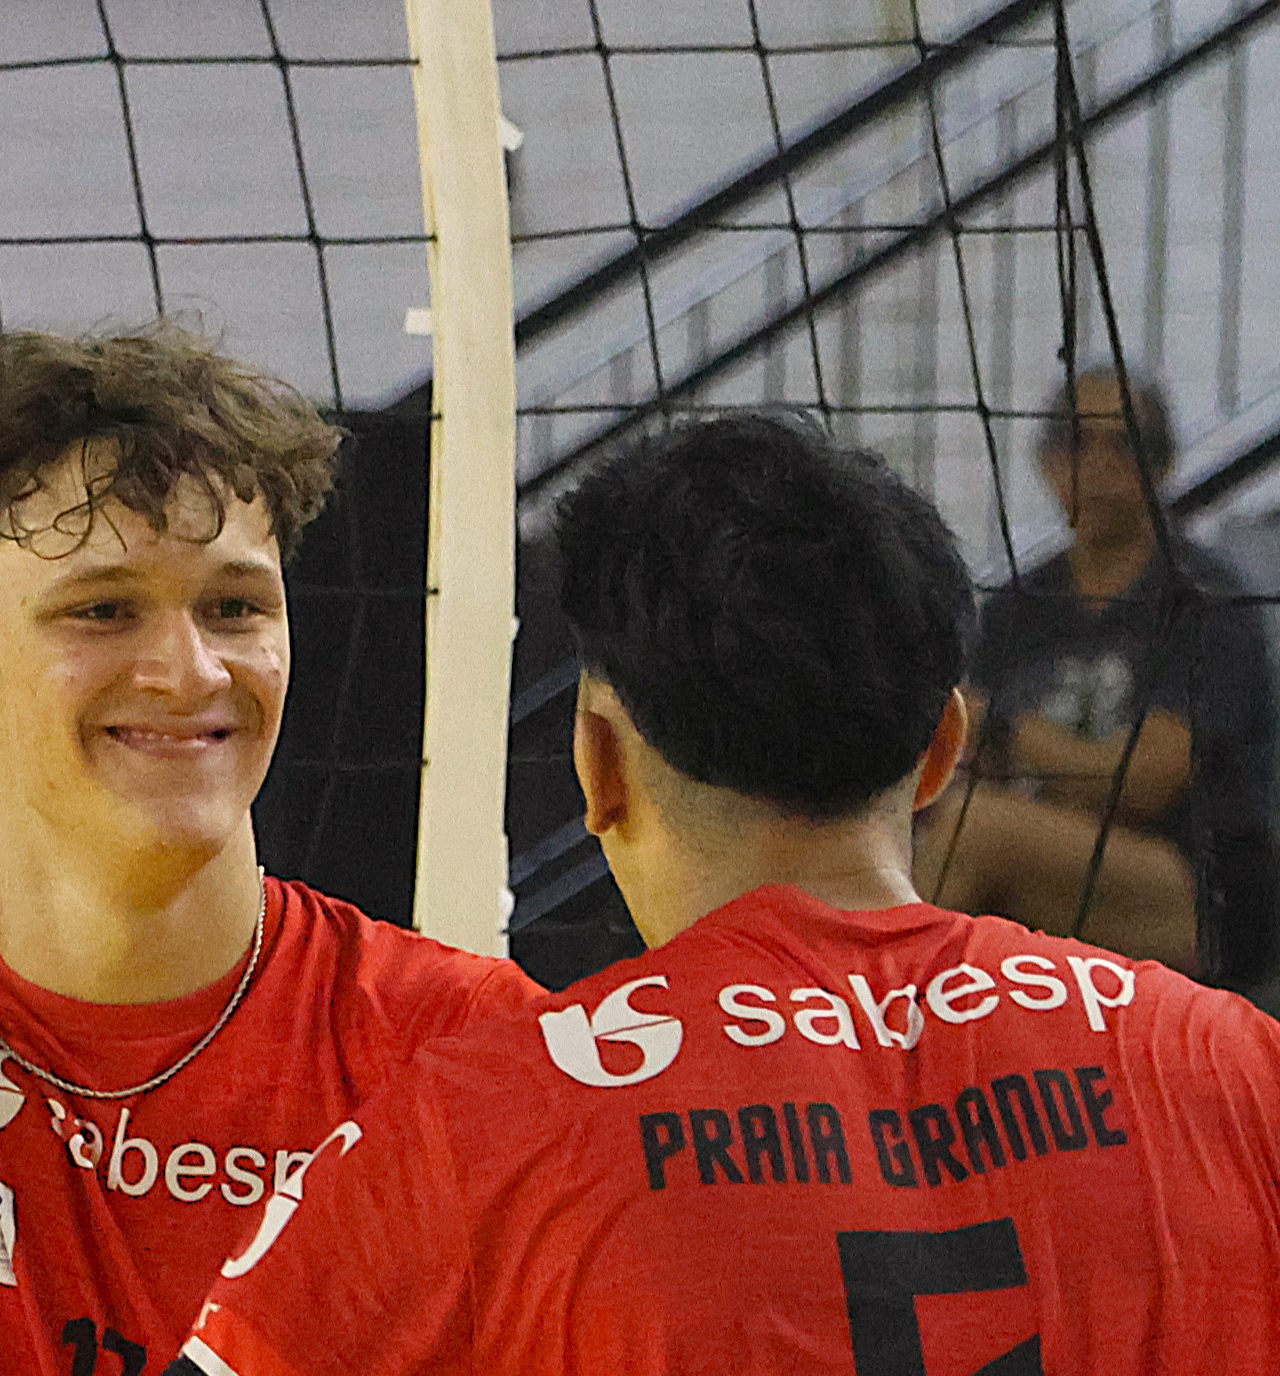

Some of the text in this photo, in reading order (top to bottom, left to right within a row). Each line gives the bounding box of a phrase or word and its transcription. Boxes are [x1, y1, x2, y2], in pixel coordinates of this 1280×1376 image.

[719, 954, 1136, 1050] sabesp
[640, 1066, 1129, 1191] PRAIA GRANDE
